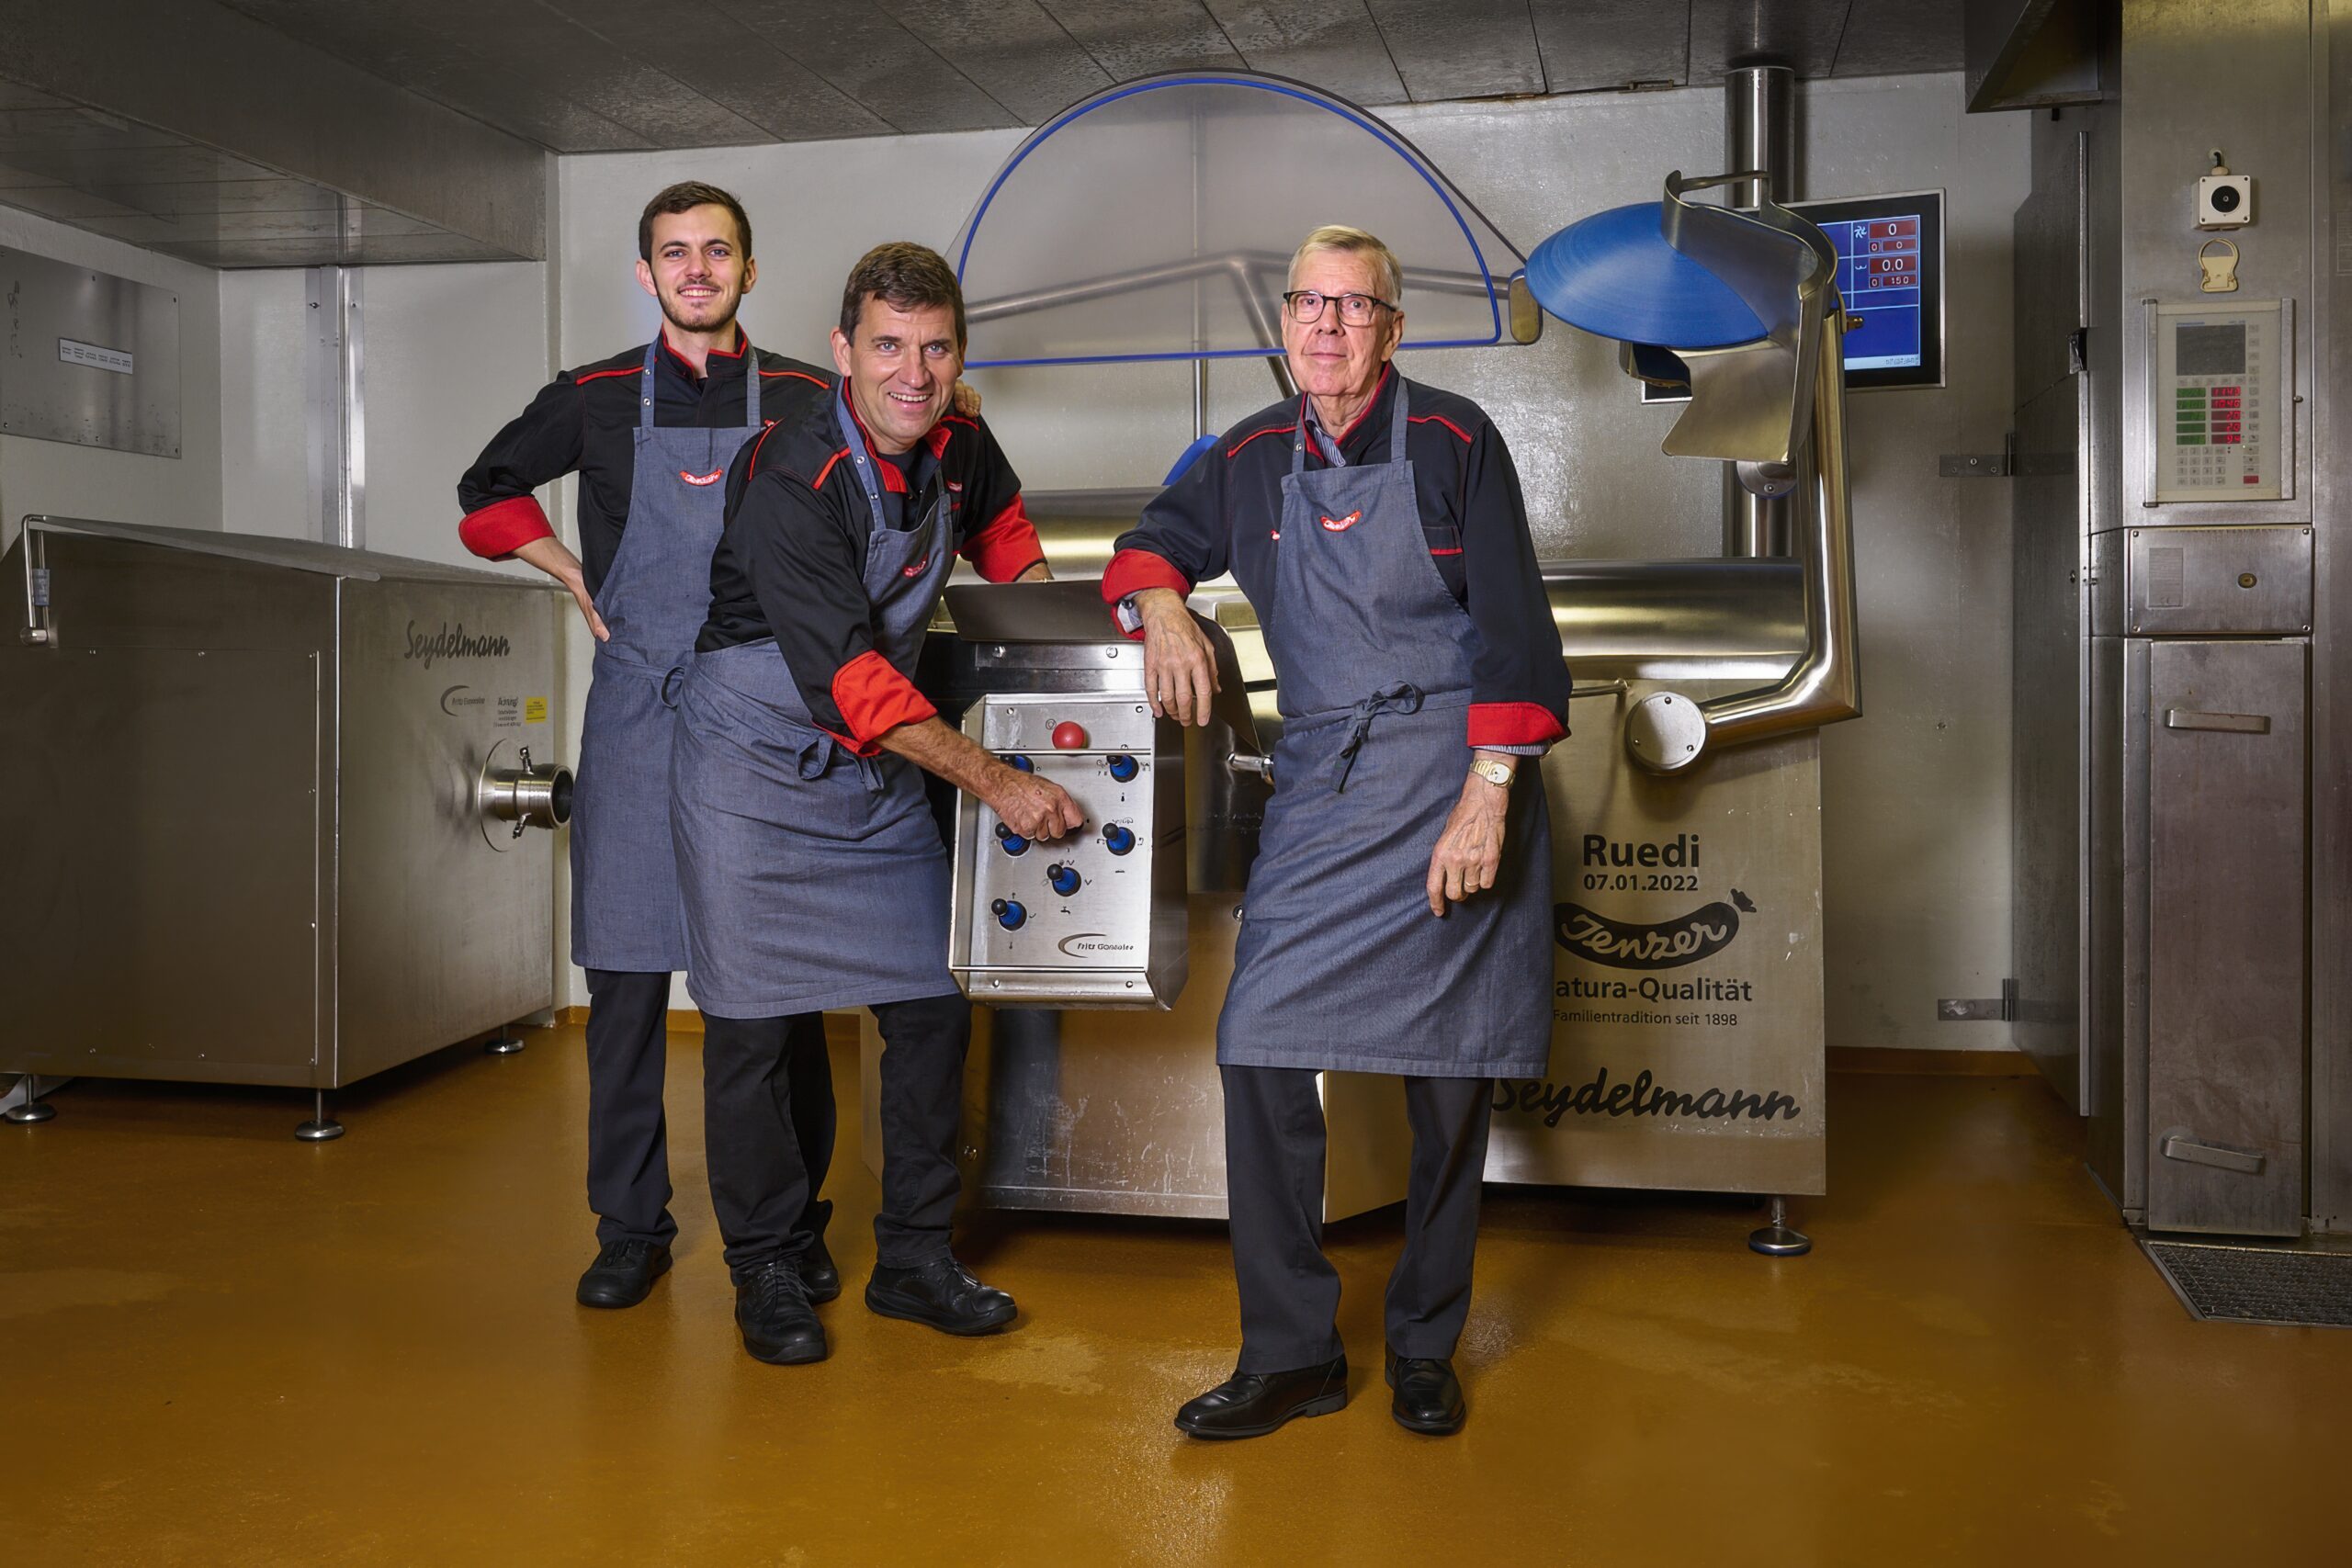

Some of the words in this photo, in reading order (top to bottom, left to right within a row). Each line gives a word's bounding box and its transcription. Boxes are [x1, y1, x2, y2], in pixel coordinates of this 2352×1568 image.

[1888, 223, 1897, 235] 0
[1896, 241, 1903, 249] 0
[404, 620, 510, 670] Seydelmann
[1583, 834, 1700, 868] Ruedi
[1583, 874, 1699, 891] 07.01.2022
[1562, 914, 1727, 960] Jenzer
[1555, 976, 1753, 1003] atura-Qualität
[1553, 1010, 1671, 1025] Familientradition
[1675, 1012, 1700, 1025] seit
[1704, 1013, 1737, 1026] 1898
